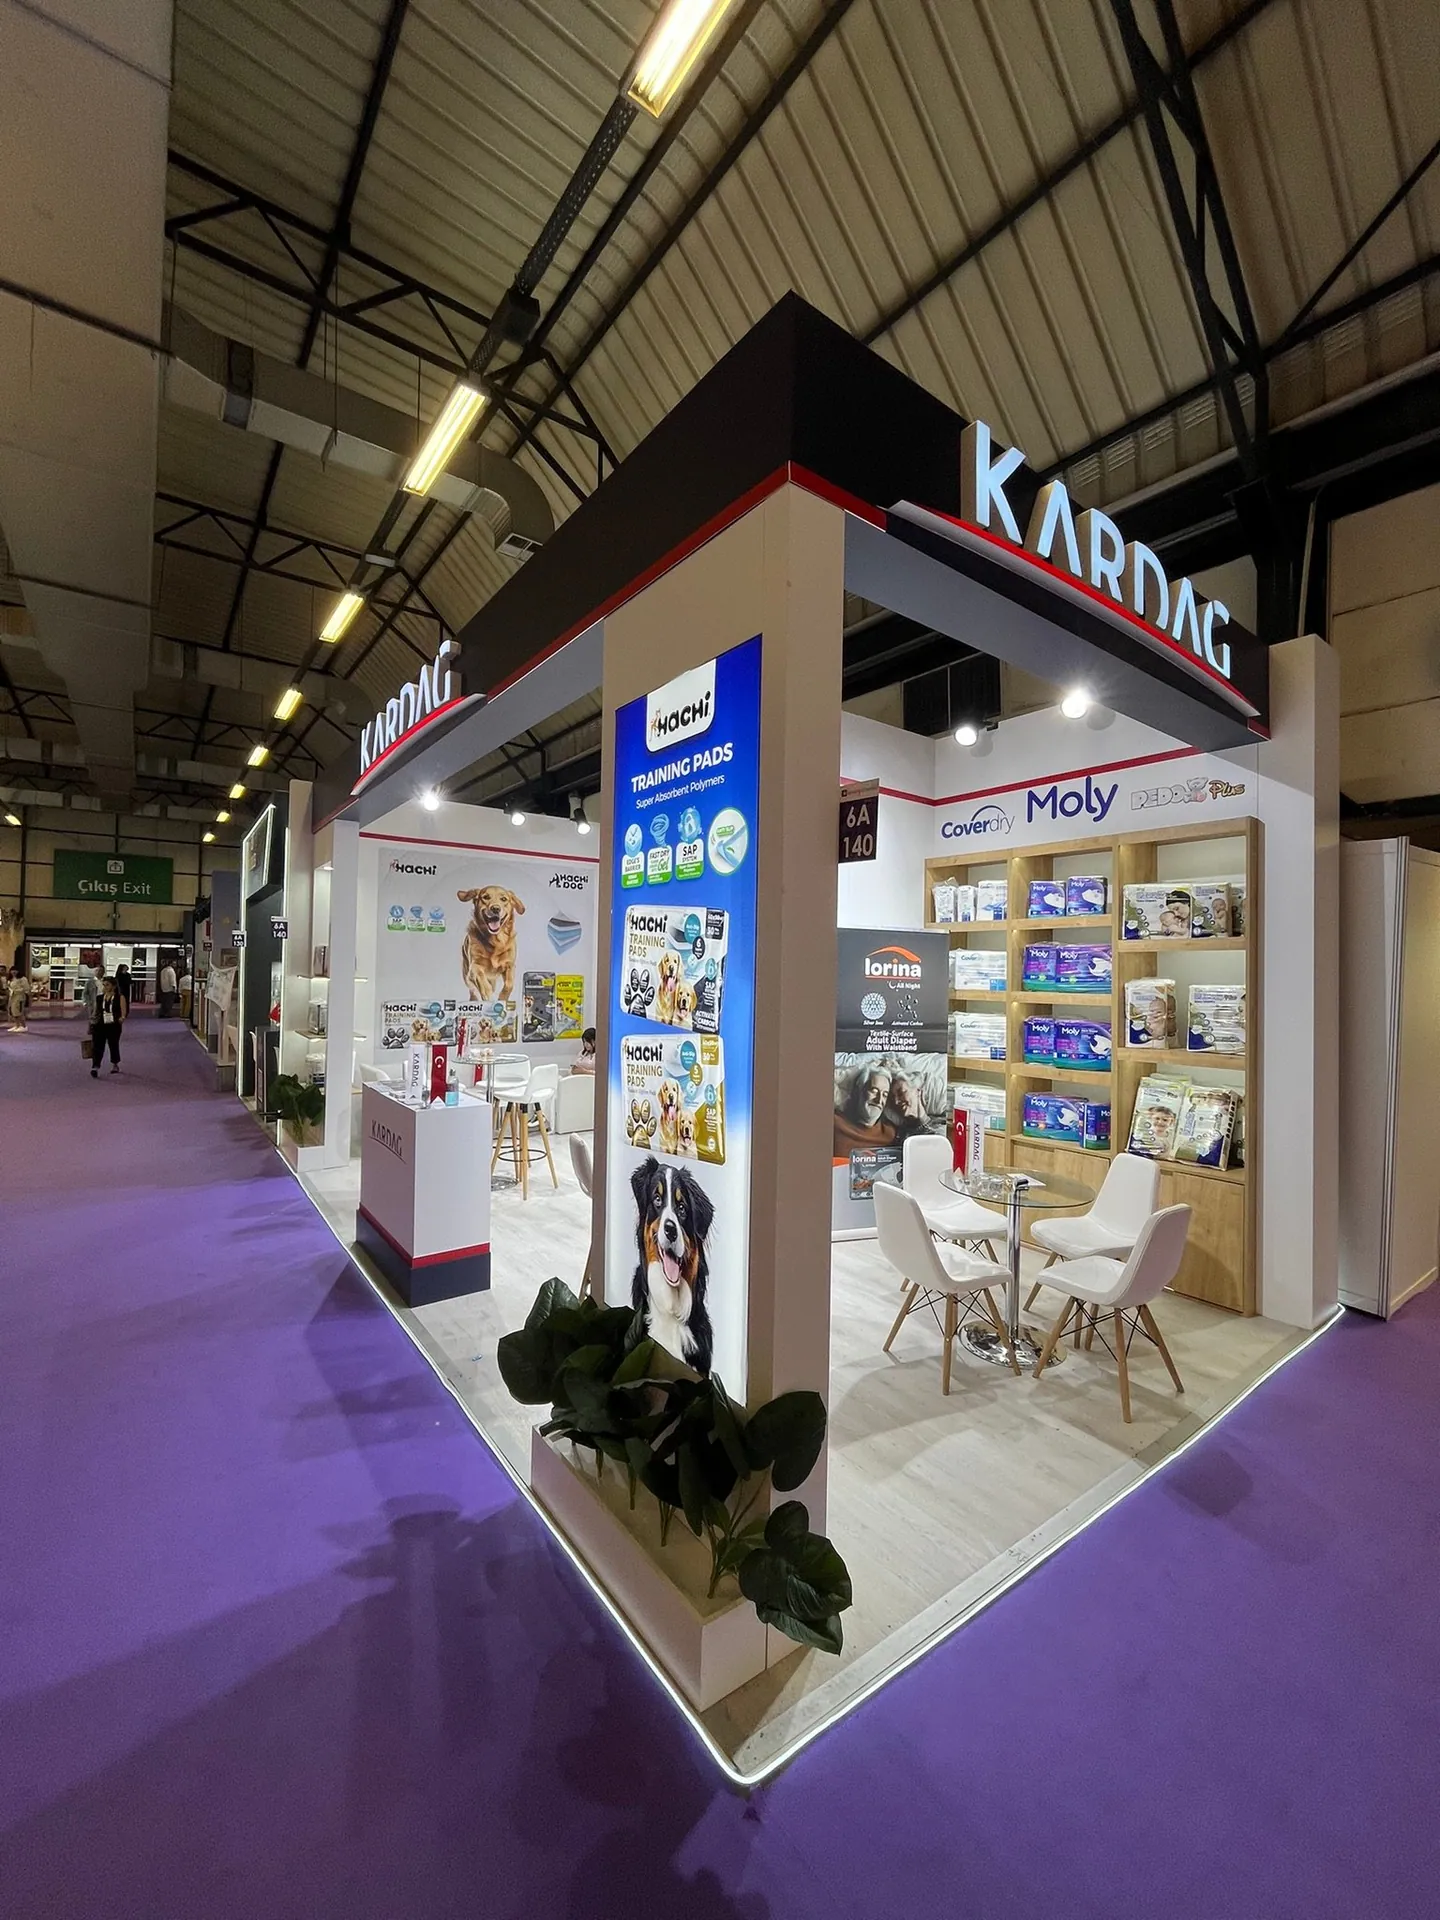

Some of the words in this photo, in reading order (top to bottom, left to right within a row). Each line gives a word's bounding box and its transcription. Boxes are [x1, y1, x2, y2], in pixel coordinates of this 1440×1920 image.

[631, 757, 690, 793] TRAINING
[693, 742, 734, 772] PADS
[636, 796, 655, 809] Super
[654, 785, 689, 804] Absorbent
[690, 774, 725, 793] Polymers
[1209, 779, 1245, 800] Plus
[1026, 775, 1119, 823] Moly
[846, 804, 870, 828] 6A
[941, 810, 1016, 839] Coverdry
[682, 844, 698, 856] SAP
[843, 833, 874, 858] 140
[78, 880, 117, 896] Çıkış
[123, 882, 151, 895] Exit
[273, 922, 285, 930] 6A
[272, 930, 287, 938] 140
[629, 933, 666, 948] TRAINING
[628, 945, 648, 958] PADS
[1031, 950, 1049, 958] Moly
[1060, 951, 1079, 960] Moly
[864, 957, 922, 978] lorina
[1032, 1025, 1050, 1033] Moly
[1061, 1027, 1080, 1036] Moly
[866, 1036, 890, 1045] Adult
[890, 1037, 917, 1046] Diaper
[627, 1064, 663, 1077] TRAINING
[693, 1065, 699, 1074] 5
[626, 1076, 646, 1088] PADS
[1031, 1097, 1048, 1108] Moly
[372, 1120, 403, 1157] KARDAG
[973, 1123, 981, 1161] KARDAG
